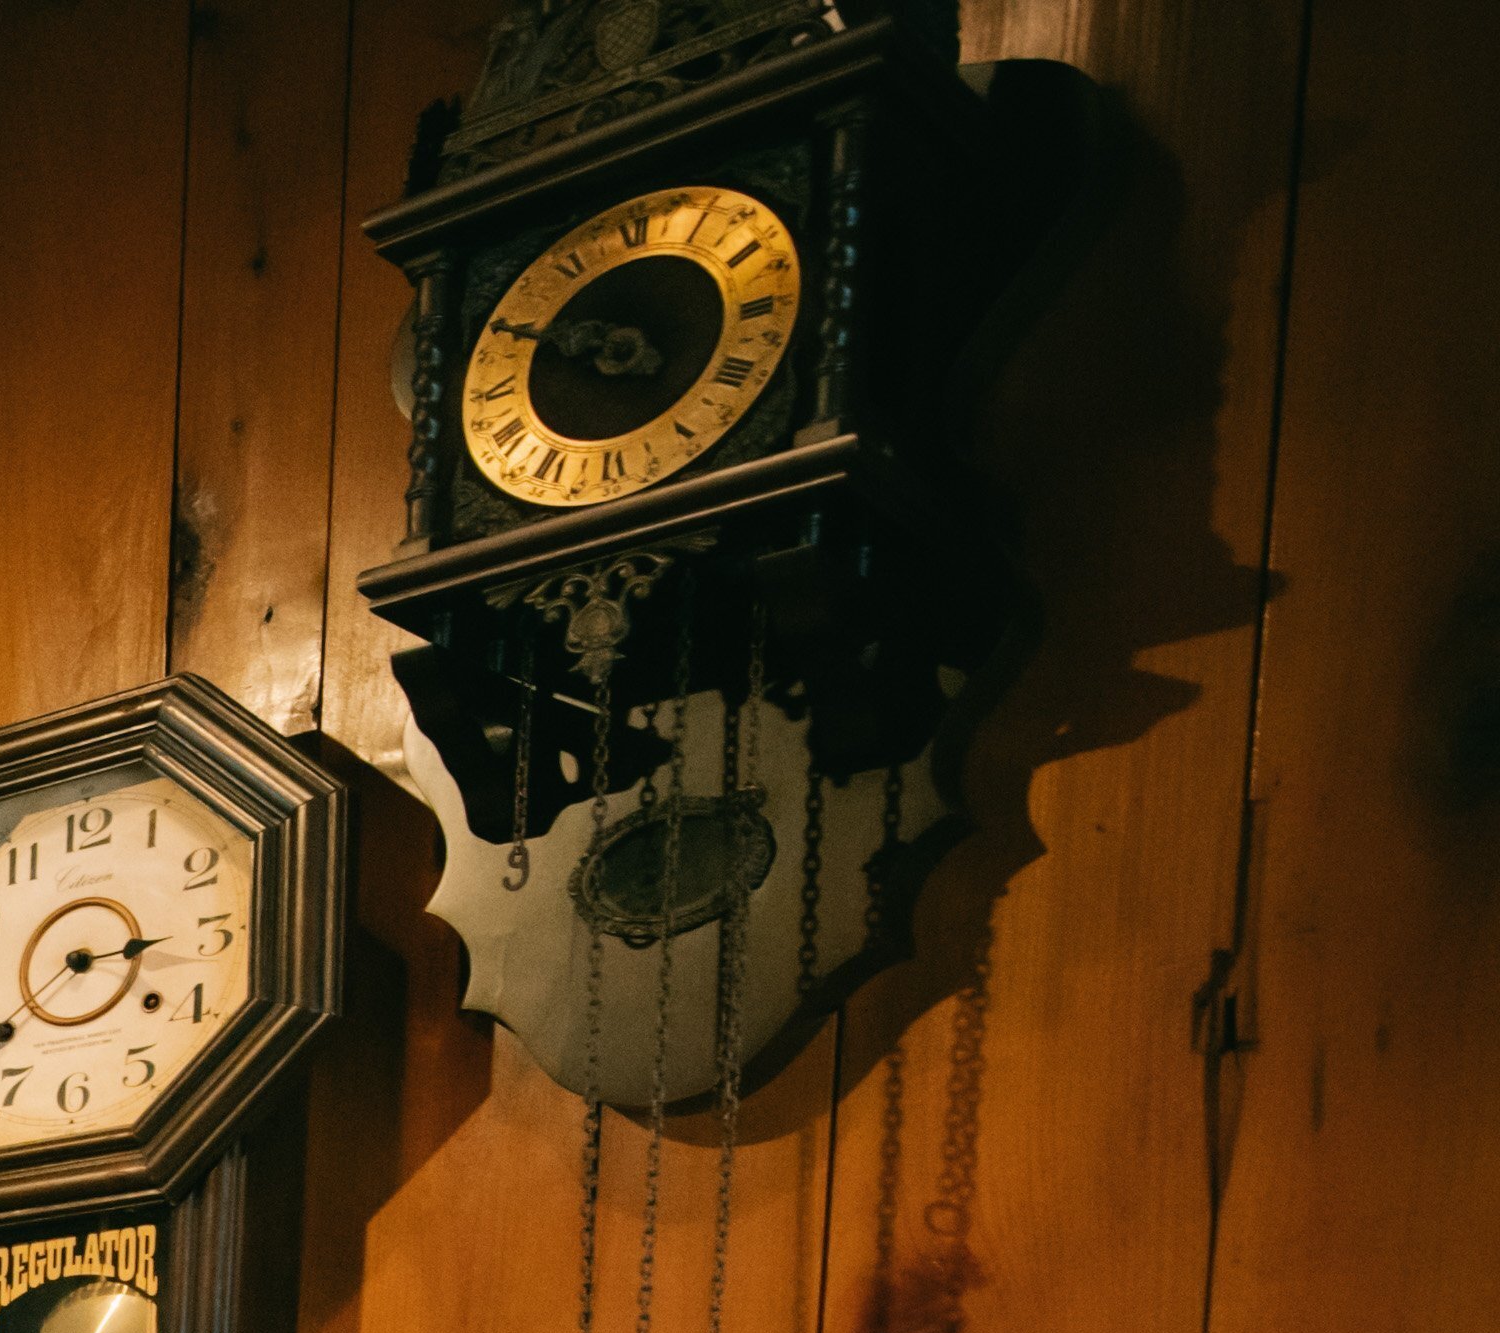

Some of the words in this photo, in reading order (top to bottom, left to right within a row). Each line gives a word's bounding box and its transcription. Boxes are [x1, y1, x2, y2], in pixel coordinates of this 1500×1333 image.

[66, 807, 113, 853] 12
[147, 809, 158, 848] 1
[8, 842, 38, 886] 11
[55, 865, 114, 892] Citizen
[183, 847, 220, 891] 2
[197, 913, 234, 956] 3
[168, 983, 211, 1024] 4
[1, 1065, 34, 1108] 7
[122, 1044, 158, 1087] 5
[56, 1072, 90, 1114] 6
